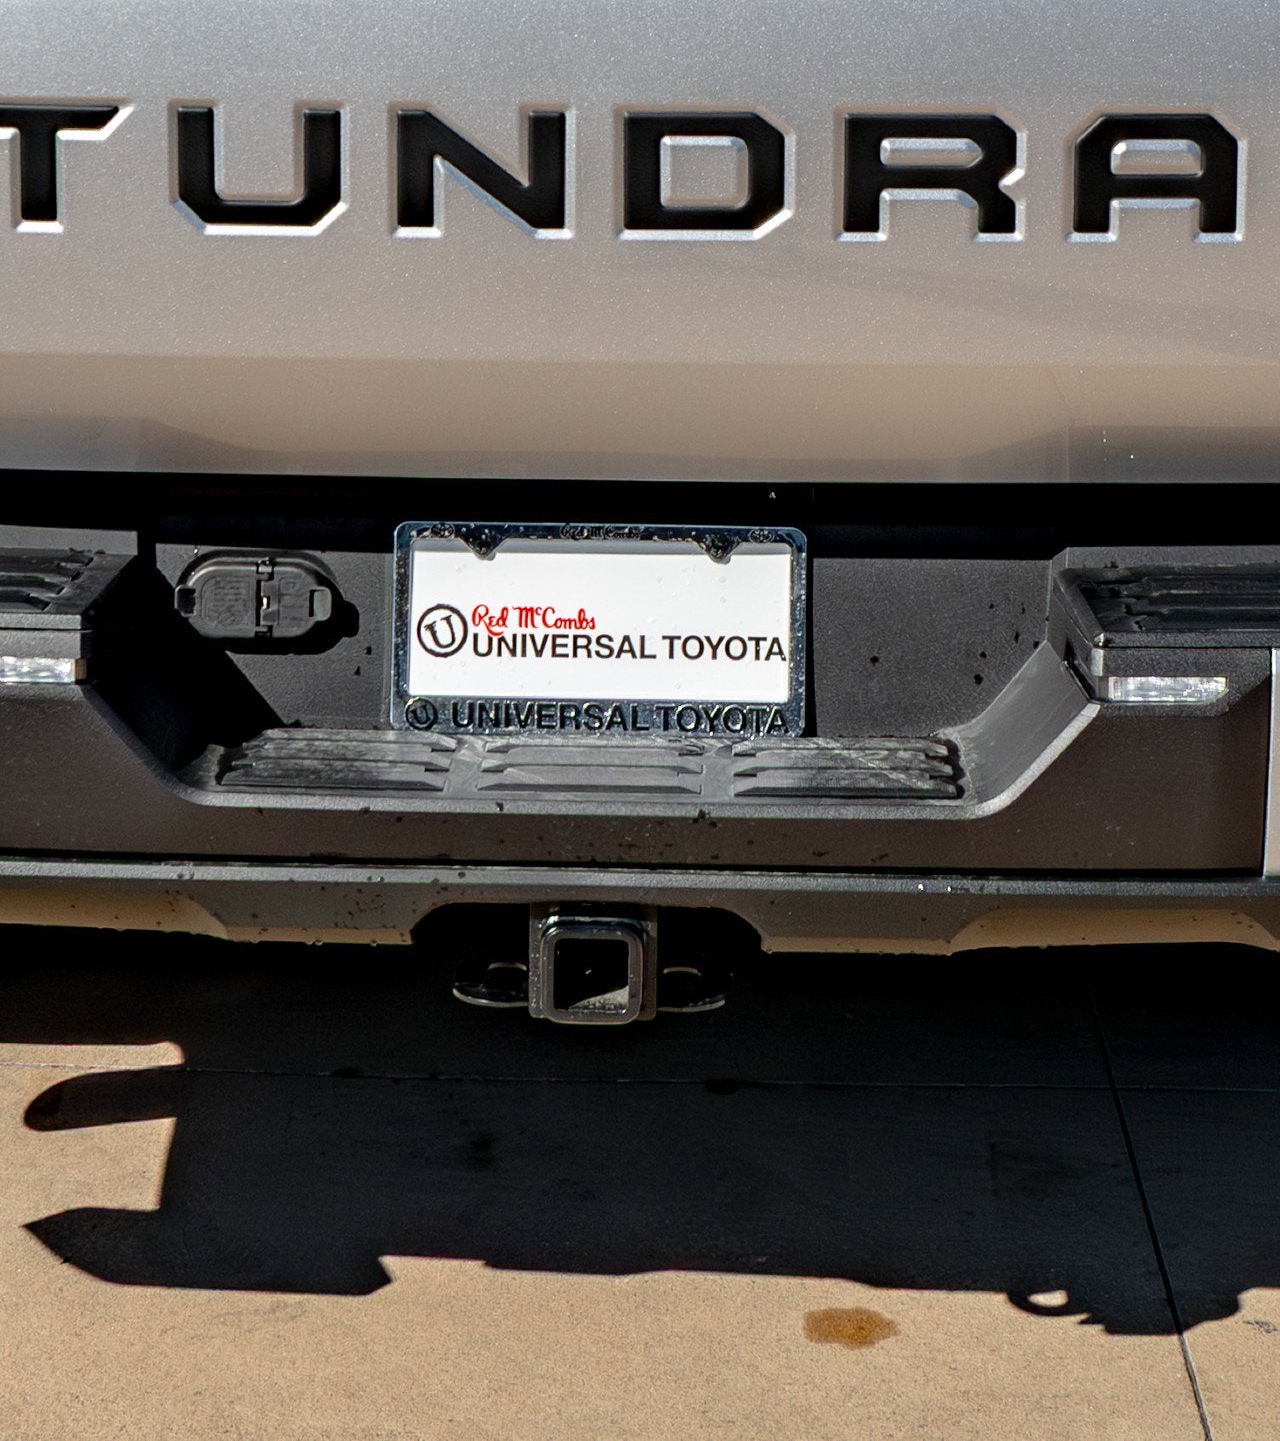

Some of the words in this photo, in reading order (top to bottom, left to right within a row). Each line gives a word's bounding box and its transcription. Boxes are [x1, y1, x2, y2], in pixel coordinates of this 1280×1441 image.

[471, 604, 508, 637] Red
[472, 632, 657, 660] UNIVERSAL
[661, 634, 787, 662] TOYOTA
[450, 700, 650, 733] UNIVERSAL
[651, 702, 789, 736] TOYOTA
